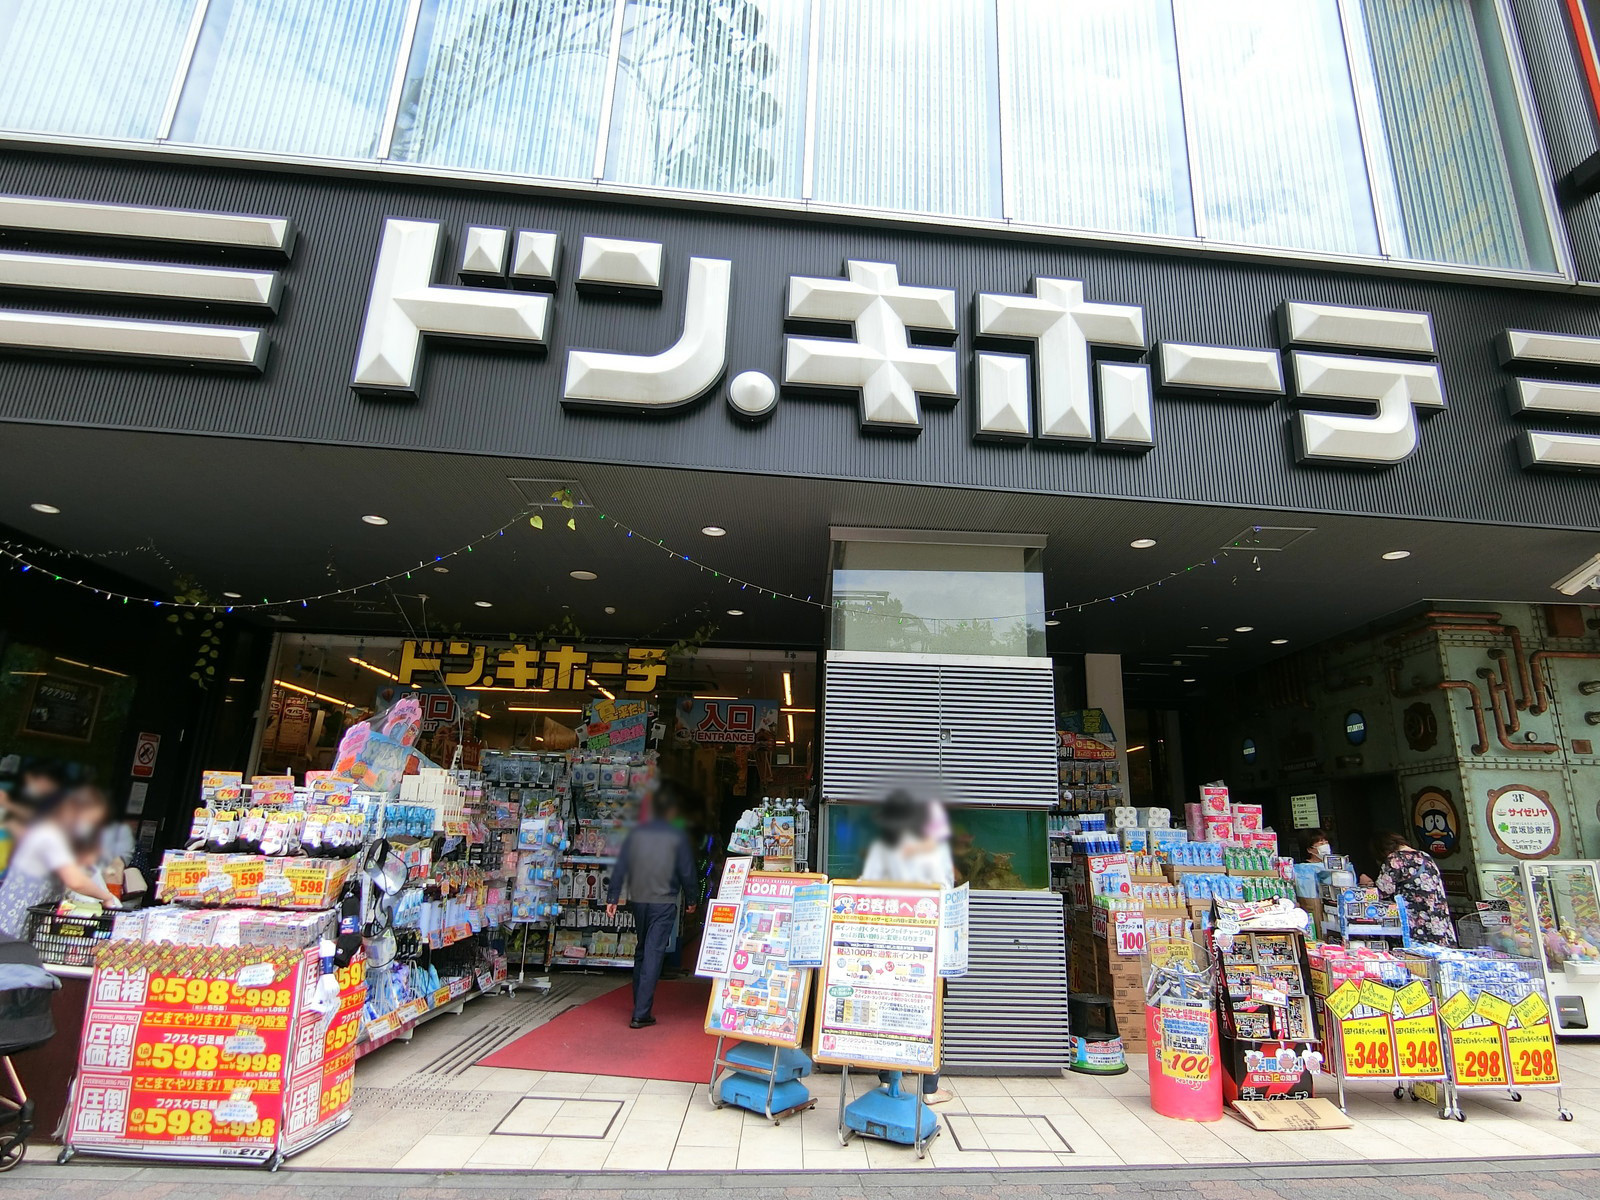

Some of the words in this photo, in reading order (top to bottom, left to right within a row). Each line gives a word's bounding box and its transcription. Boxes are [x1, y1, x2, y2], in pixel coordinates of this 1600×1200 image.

[698, 702, 756, 732] 入口
[696, 732, 756, 743] ENTRANCE
[1512, 794, 1525, 802] 3F
[1508, 808, 1548, 817] サイゼリヤ
[241, 871, 265, 886] 598
[299, 879, 324, 893] 598
[745, 882, 778, 895] LOOR
[857, 897, 914, 914] お客様へ
[1122, 932, 1144, 950] 100
[736, 954, 747, 965] 2F
[97, 980, 146, 1001] 価格
[164, 977, 230, 1005] 598
[245, 988, 291, 1007] 998
[143, 1010, 229, 1026] ここまでやります!
[724, 1011, 735, 1025] 1F
[88, 1023, 135, 1046] 圧倒
[85, 1044, 131, 1067] 価格
[151, 1042, 219, 1070] 598
[236, 1053, 282, 1071] 998
[1171, 1053, 1210, 1074] 100
[1354, 1041, 1389, 1069] 348
[1405, 1041, 1438, 1068] 348
[1464, 1050, 1501, 1077] 298
[1519, 1049, 1554, 1077] 298
[135, 1076, 221, 1092] ここまでやります!
[81, 1088, 128, 1110] 圧倒
[78, 1109, 124, 1132] 価格
[144, 1107, 213, 1135] 598
[230, 1118, 276, 1136] 998
